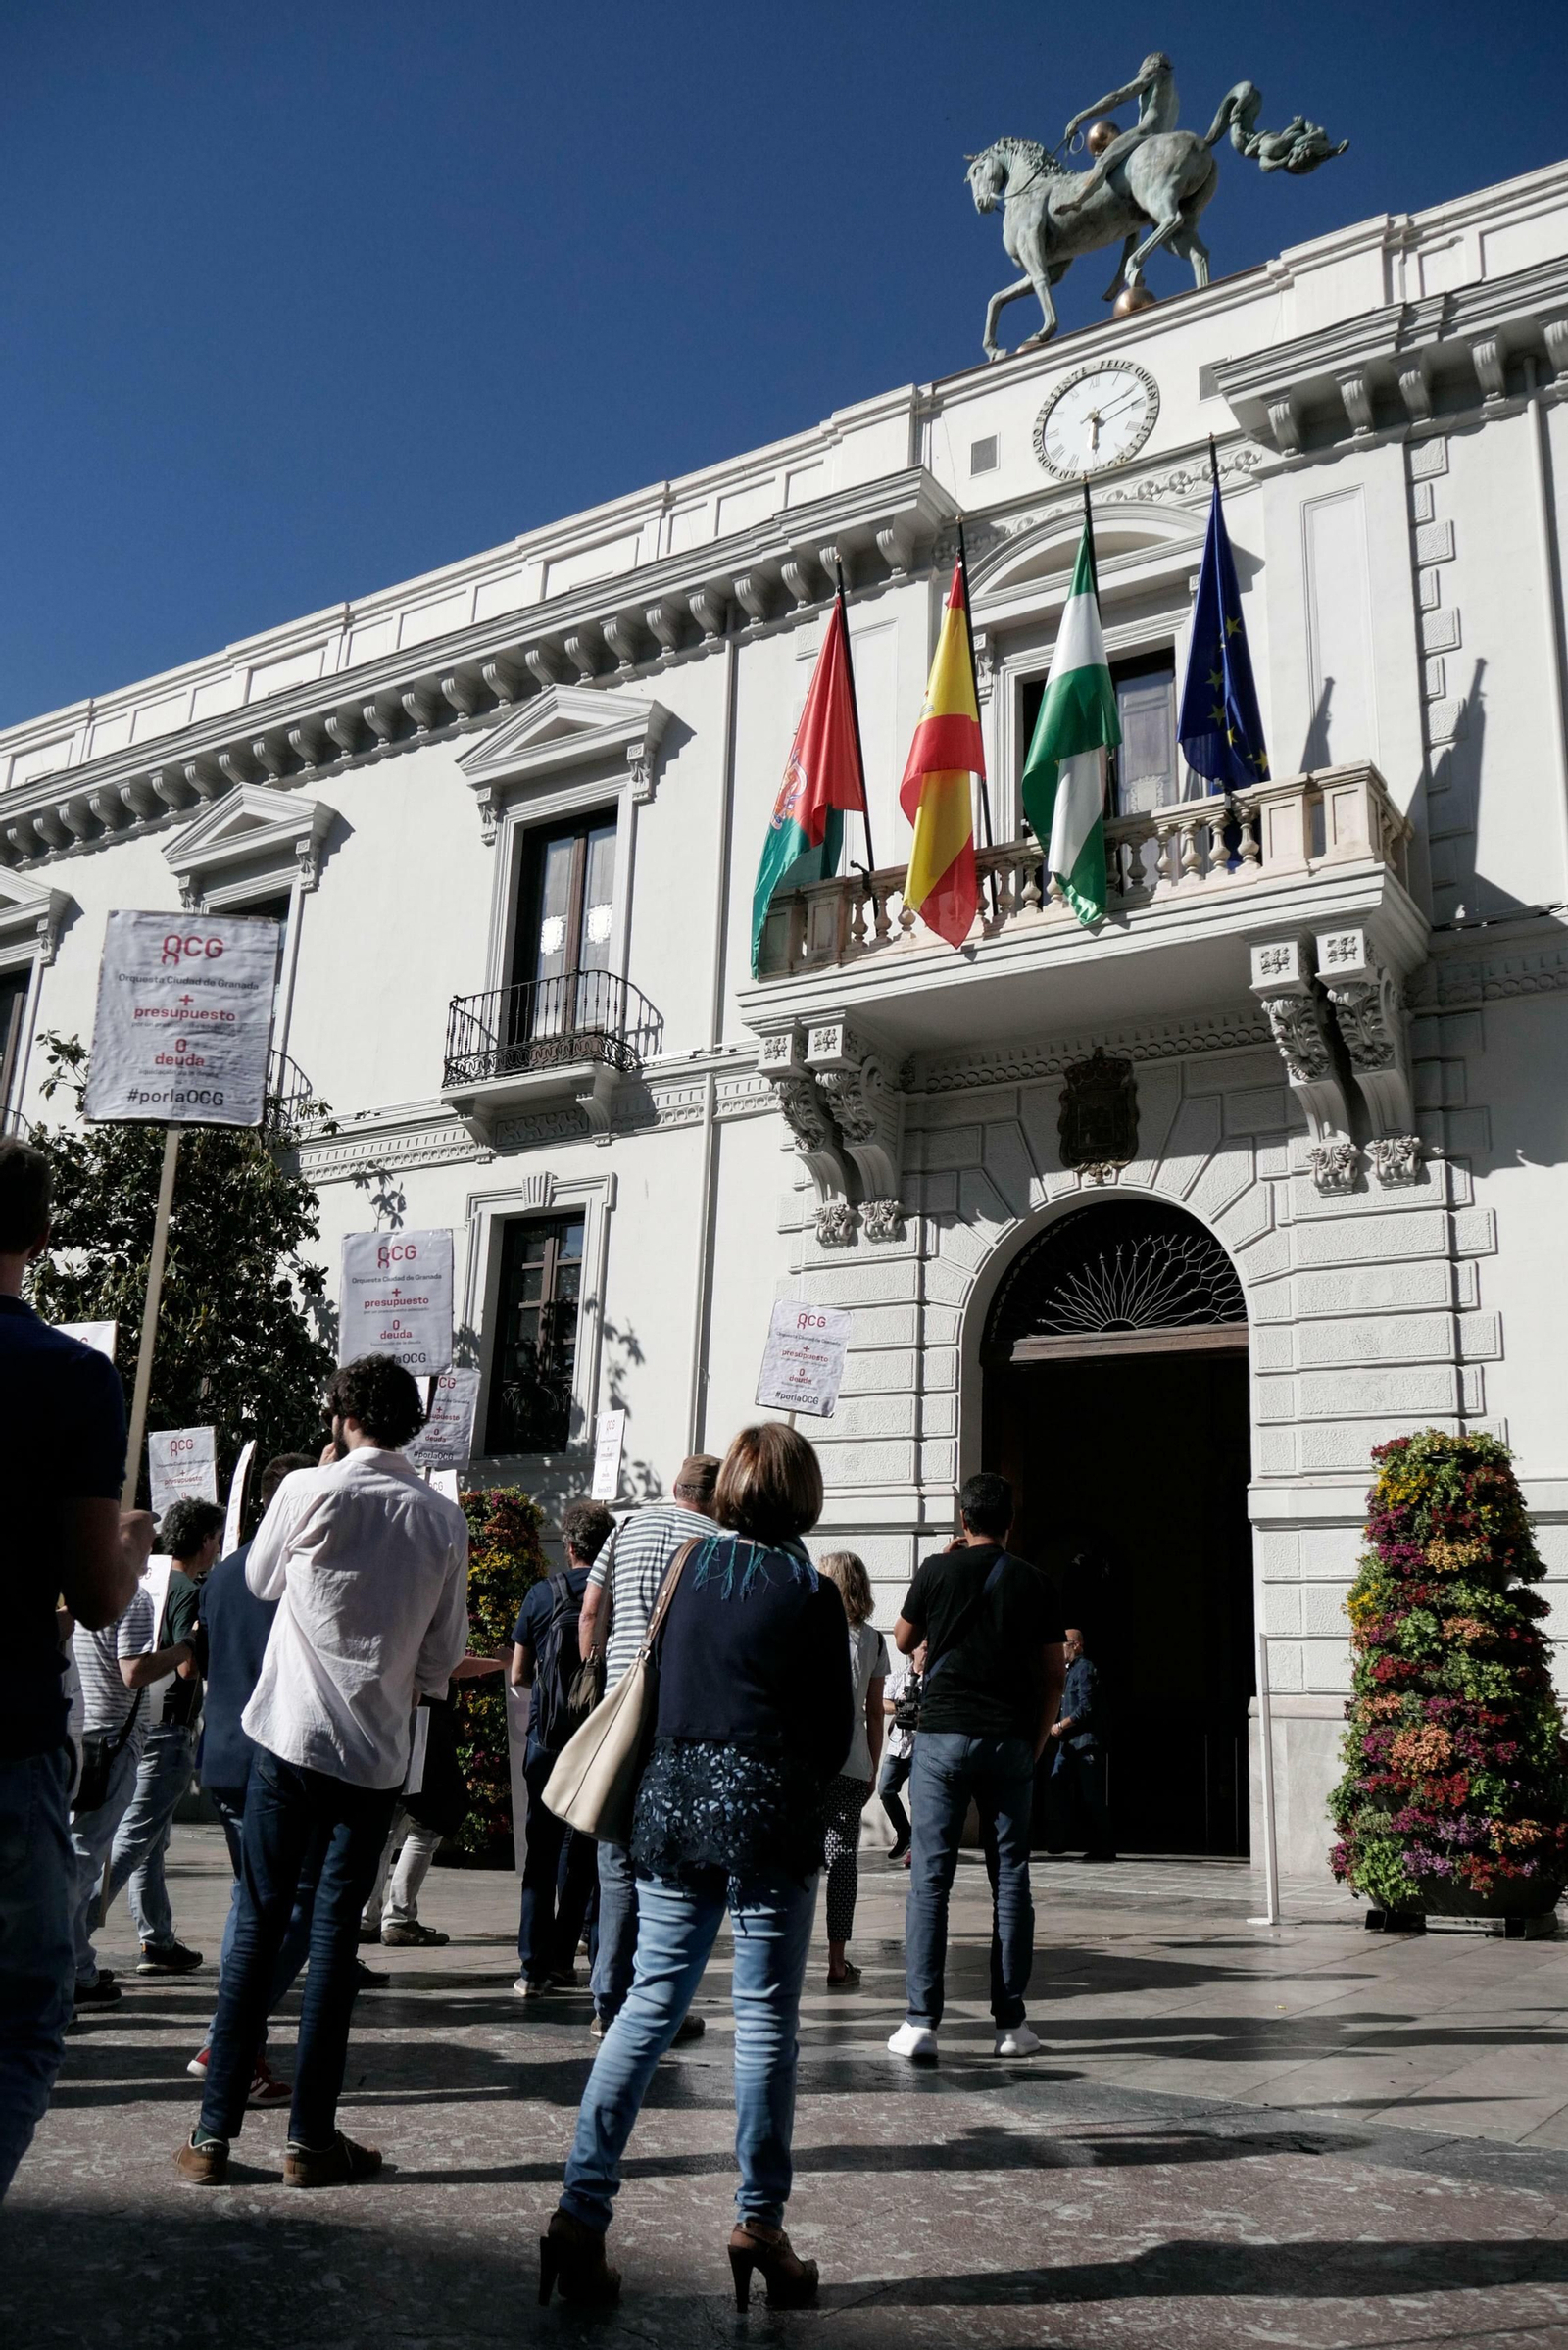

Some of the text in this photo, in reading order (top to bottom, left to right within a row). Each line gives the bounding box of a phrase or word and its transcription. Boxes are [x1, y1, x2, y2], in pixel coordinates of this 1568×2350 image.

[1100, 360, 1135, 370] FELIZ
[1135, 367, 1158, 401] QUIEN
[1033, 428, 1057, 474] DORADO
[119, 973, 259, 990] Orquesta Ciudad de Granada
[134, 1006, 236, 1022] presupuesto
[175, 1038, 187, 1053] 0
[155, 1053, 205, 1066] deuda
[126, 1088, 224, 1106] #porlaOCG
[364, 1297, 429, 1309] presupuesto
[392, 1319, 400, 1330] 0
[380, 1329, 413, 1340] deuda
[782, 1350, 828, 1362] presupuesto
[438, 1377, 456, 1389] CG
[789, 1375, 812, 1385] deuda
[775, 1392, 819, 1405] #porlaOCG
[414, 1450, 454, 1460] #porlaOCG
[164, 1476, 202, 1486] presupuesto
